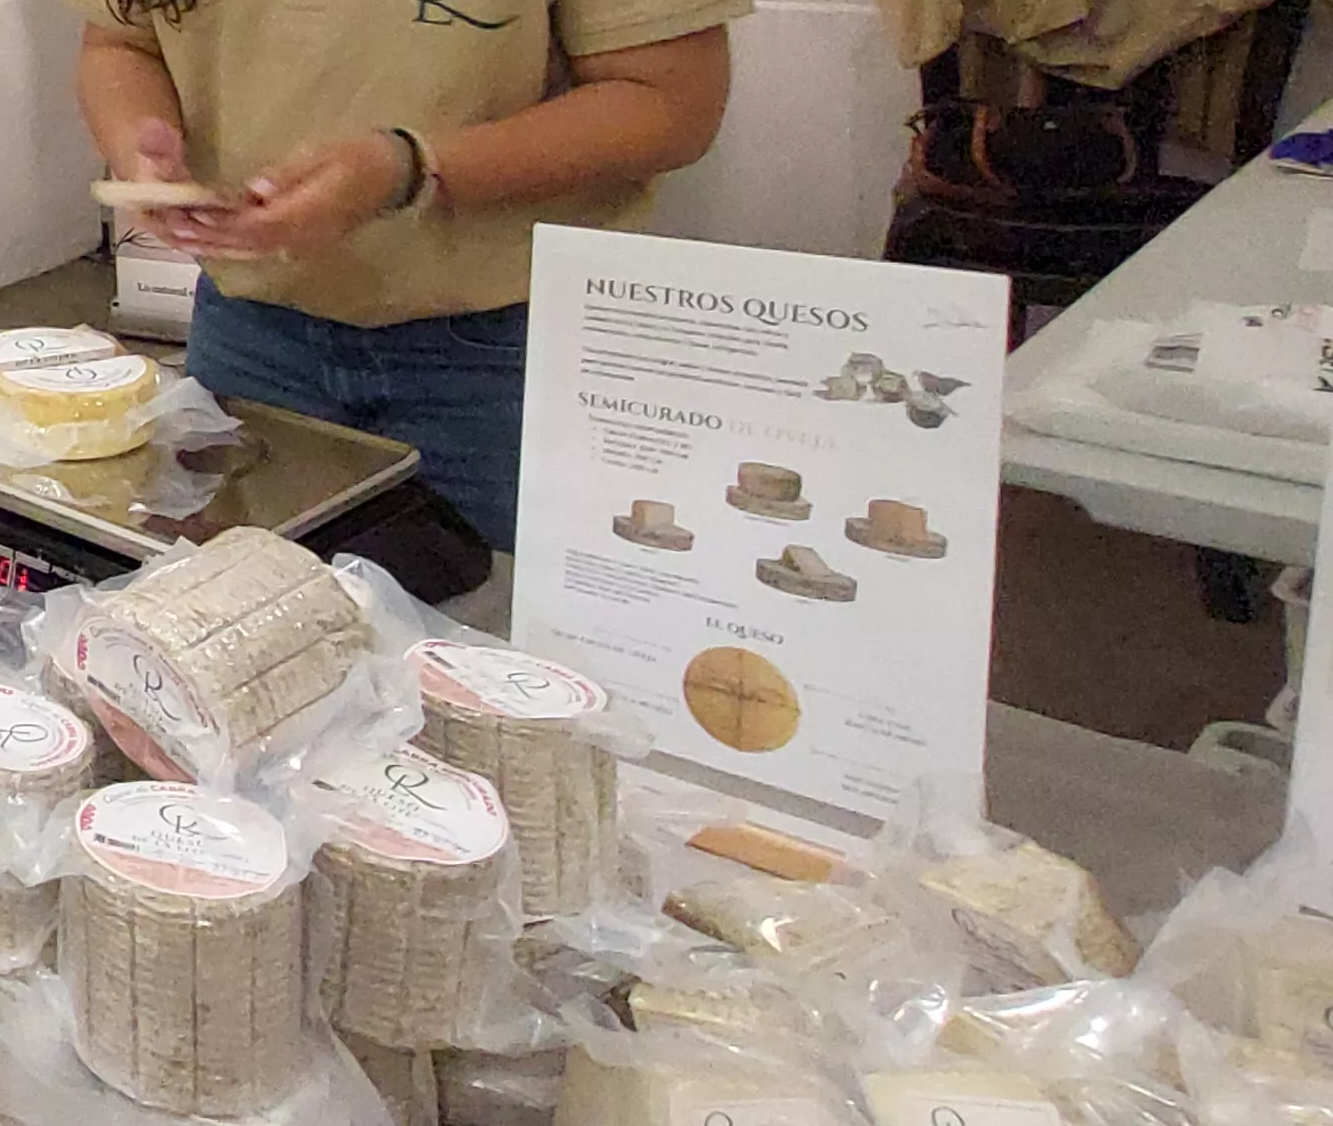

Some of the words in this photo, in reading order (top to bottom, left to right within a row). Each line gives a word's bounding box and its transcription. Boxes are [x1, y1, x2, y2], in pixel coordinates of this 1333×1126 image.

[585, 277, 734, 315] NUESTROS
[742, 298, 870, 333] QUESOS
[577, 390, 723, 430] SEMICURADO
